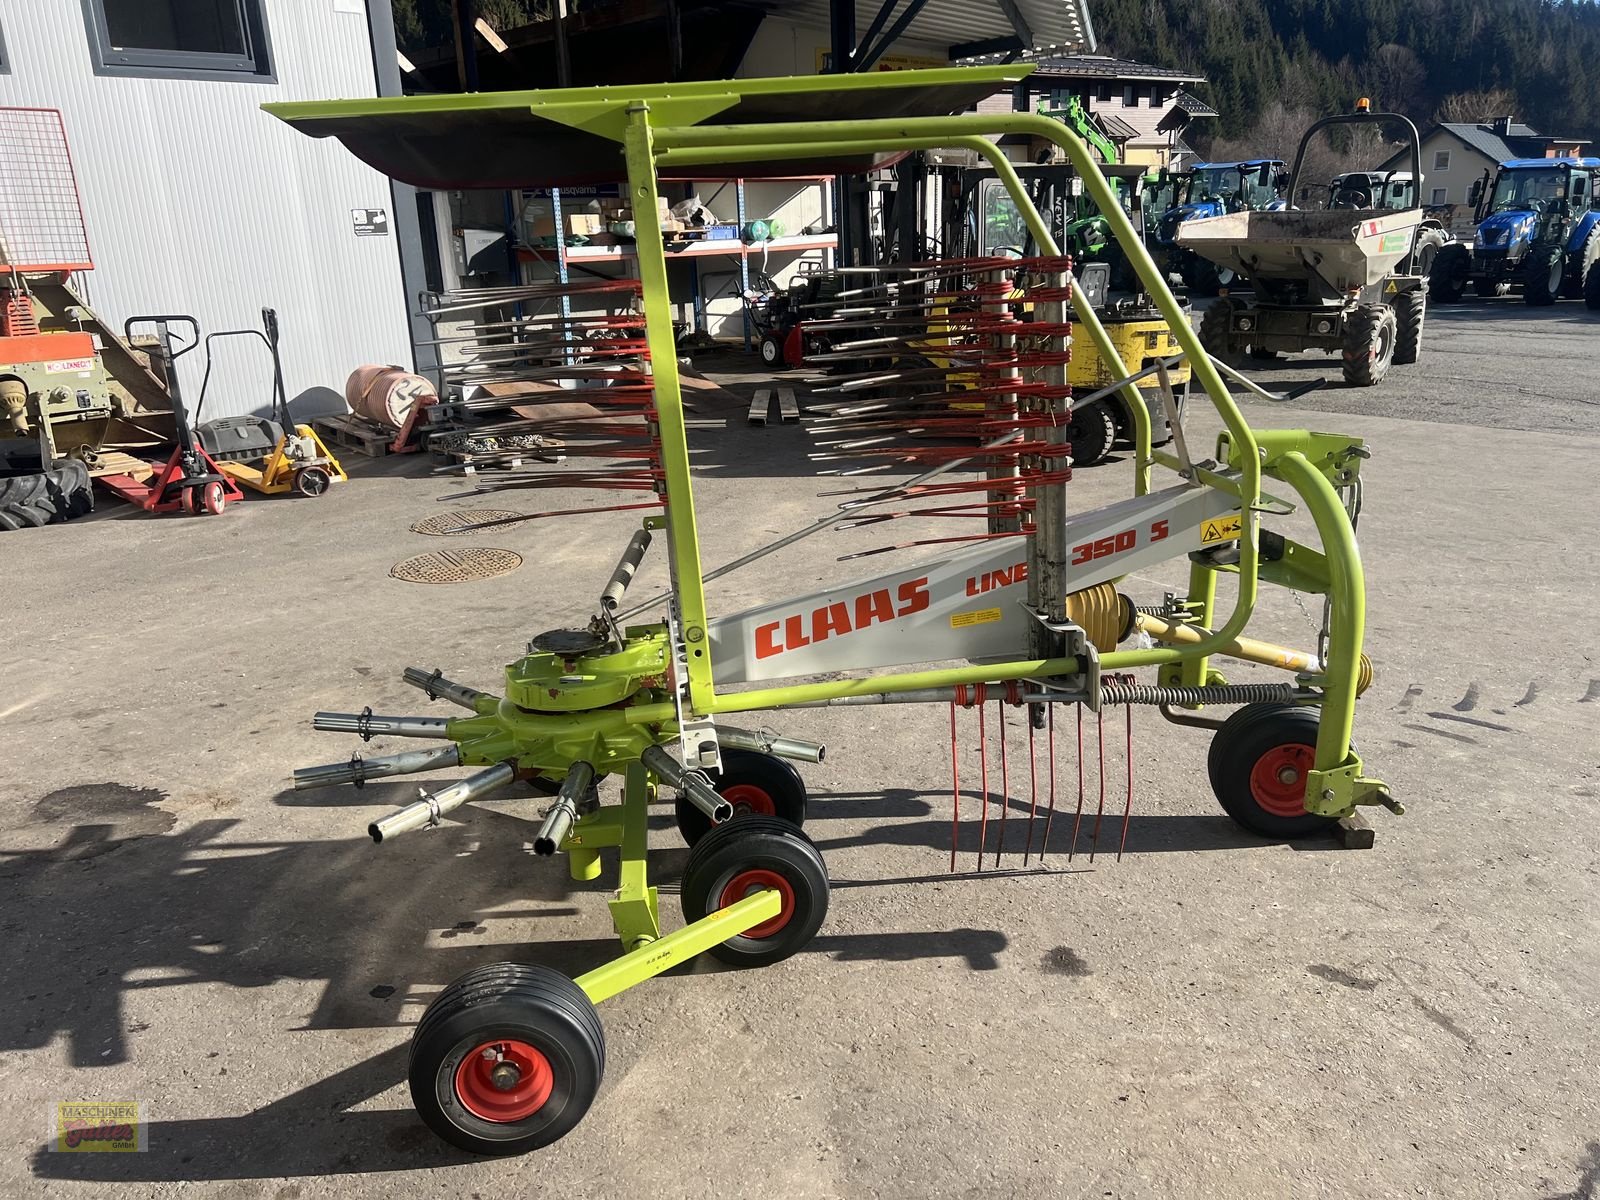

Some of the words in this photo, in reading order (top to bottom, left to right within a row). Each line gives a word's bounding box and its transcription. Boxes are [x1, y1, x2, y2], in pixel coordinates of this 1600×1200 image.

[556, 185, 597, 197] usqvarna
[1072, 529, 1136, 566] 350
[1151, 519, 1168, 543] S
[755, 577, 930, 660] CLAAS
